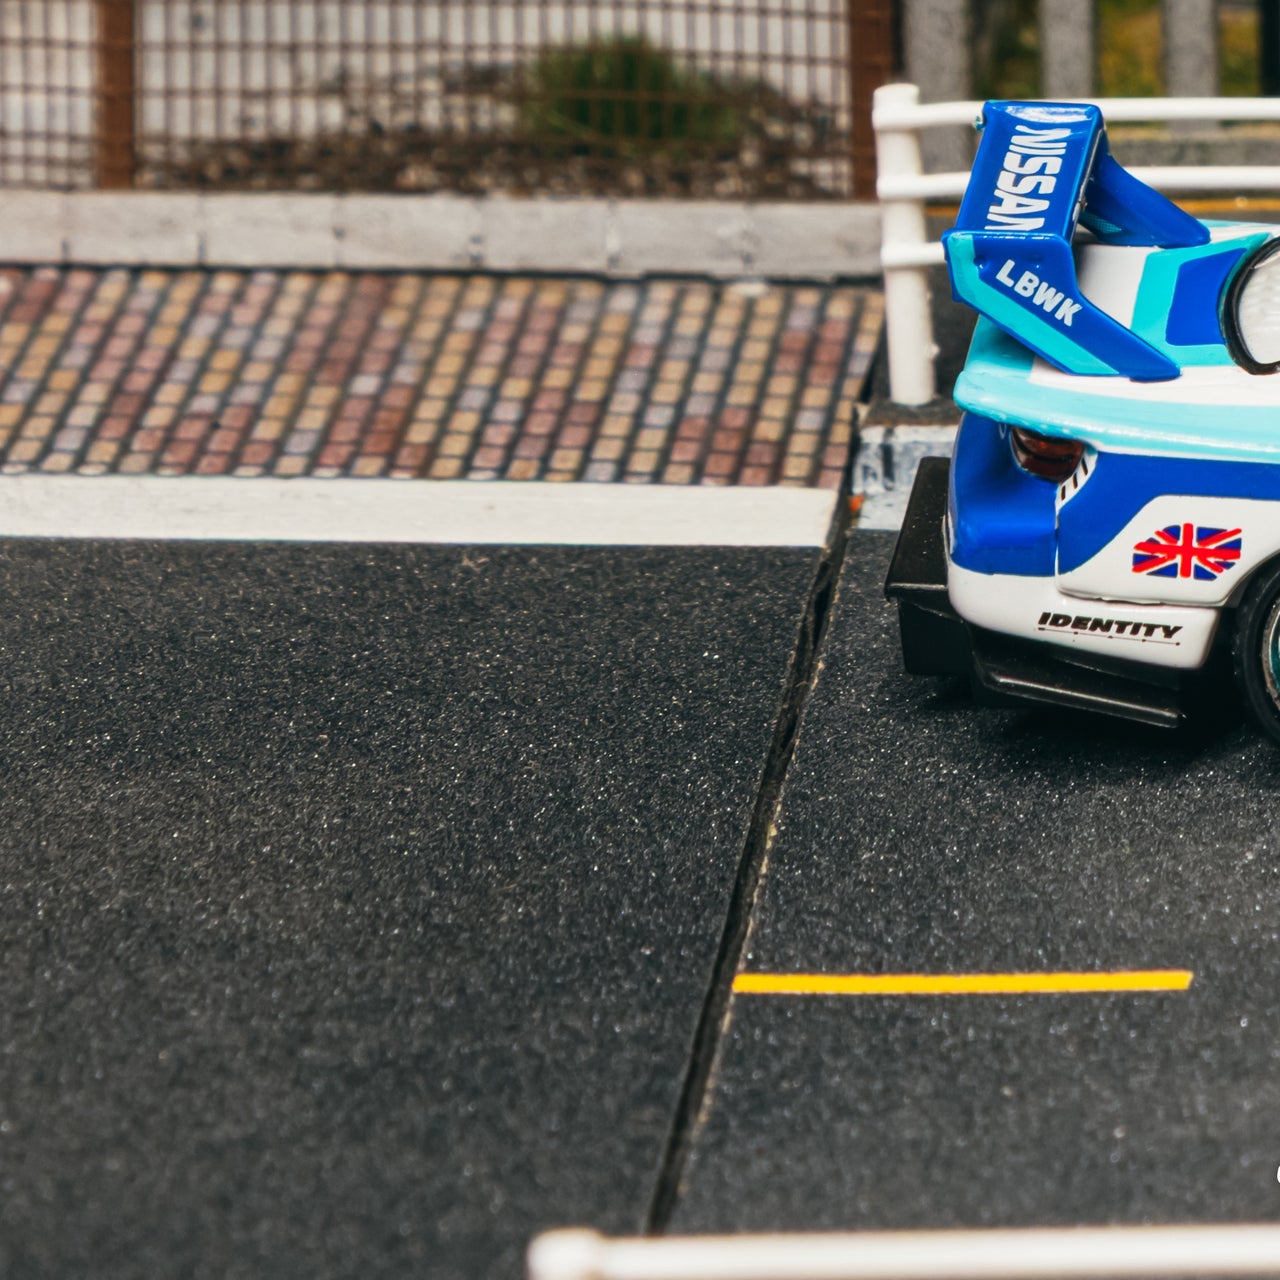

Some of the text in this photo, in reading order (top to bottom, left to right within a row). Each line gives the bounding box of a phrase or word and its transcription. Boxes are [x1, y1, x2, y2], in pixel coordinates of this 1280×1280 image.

[984, 124, 1072, 231] NISSAN
[996, 259, 1083, 327] LBWK
[1037, 612, 1183, 639] IDENTITY
